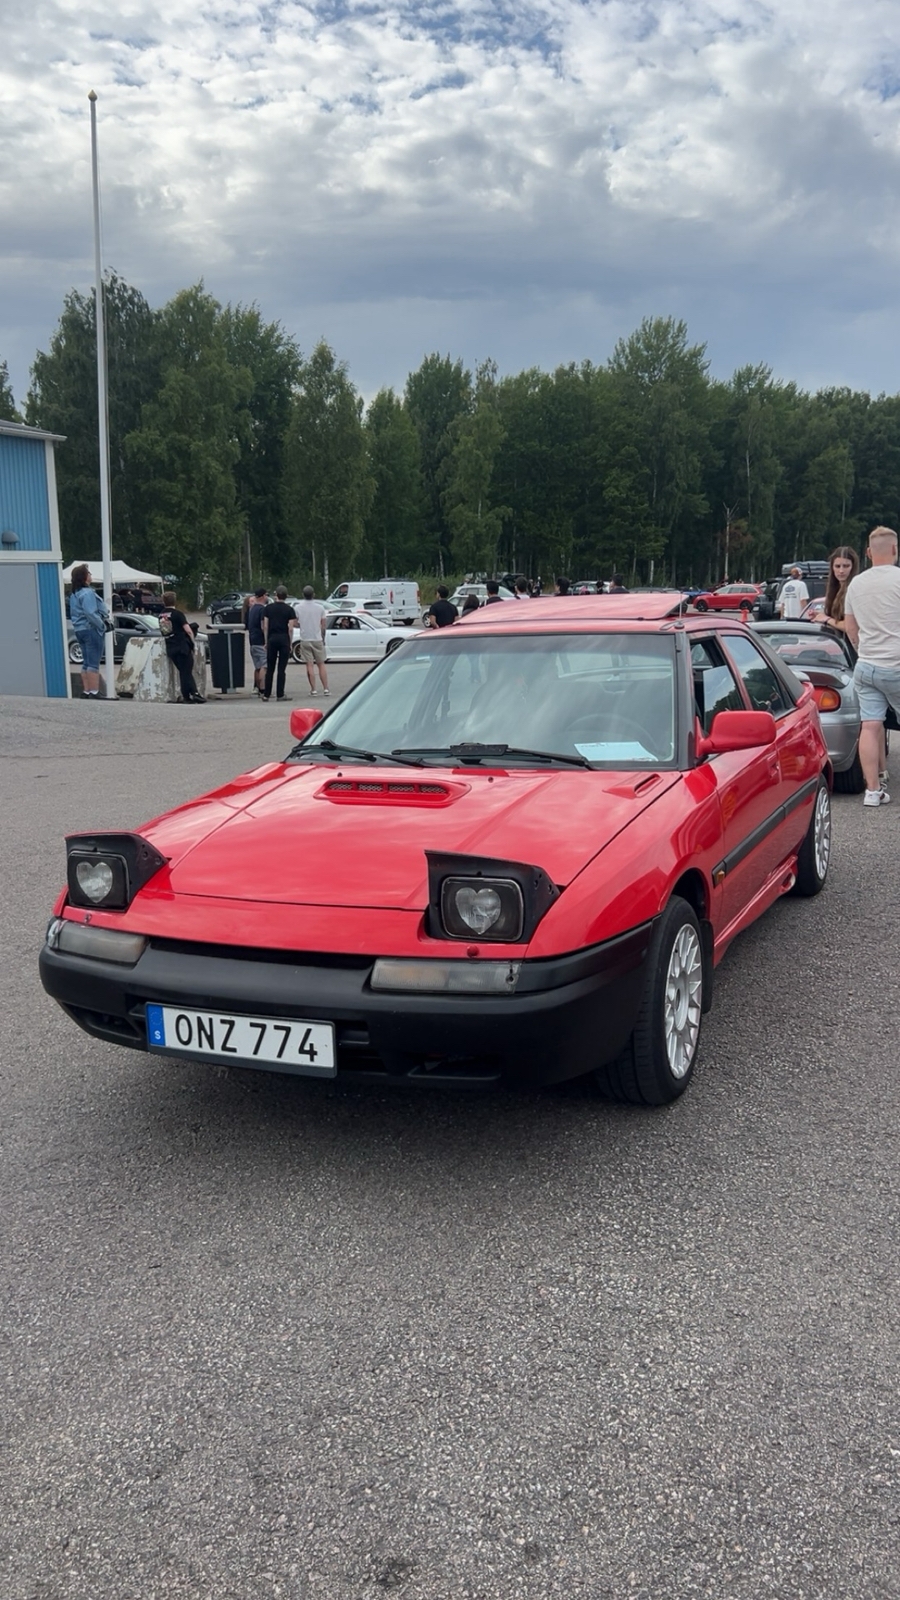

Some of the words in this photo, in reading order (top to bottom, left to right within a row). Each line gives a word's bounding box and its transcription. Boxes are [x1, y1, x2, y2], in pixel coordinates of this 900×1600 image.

[154, 1030, 161, 1040] S
[175, 1014, 237, 1053] ONZ
[249, 1022, 318, 1062] 774
